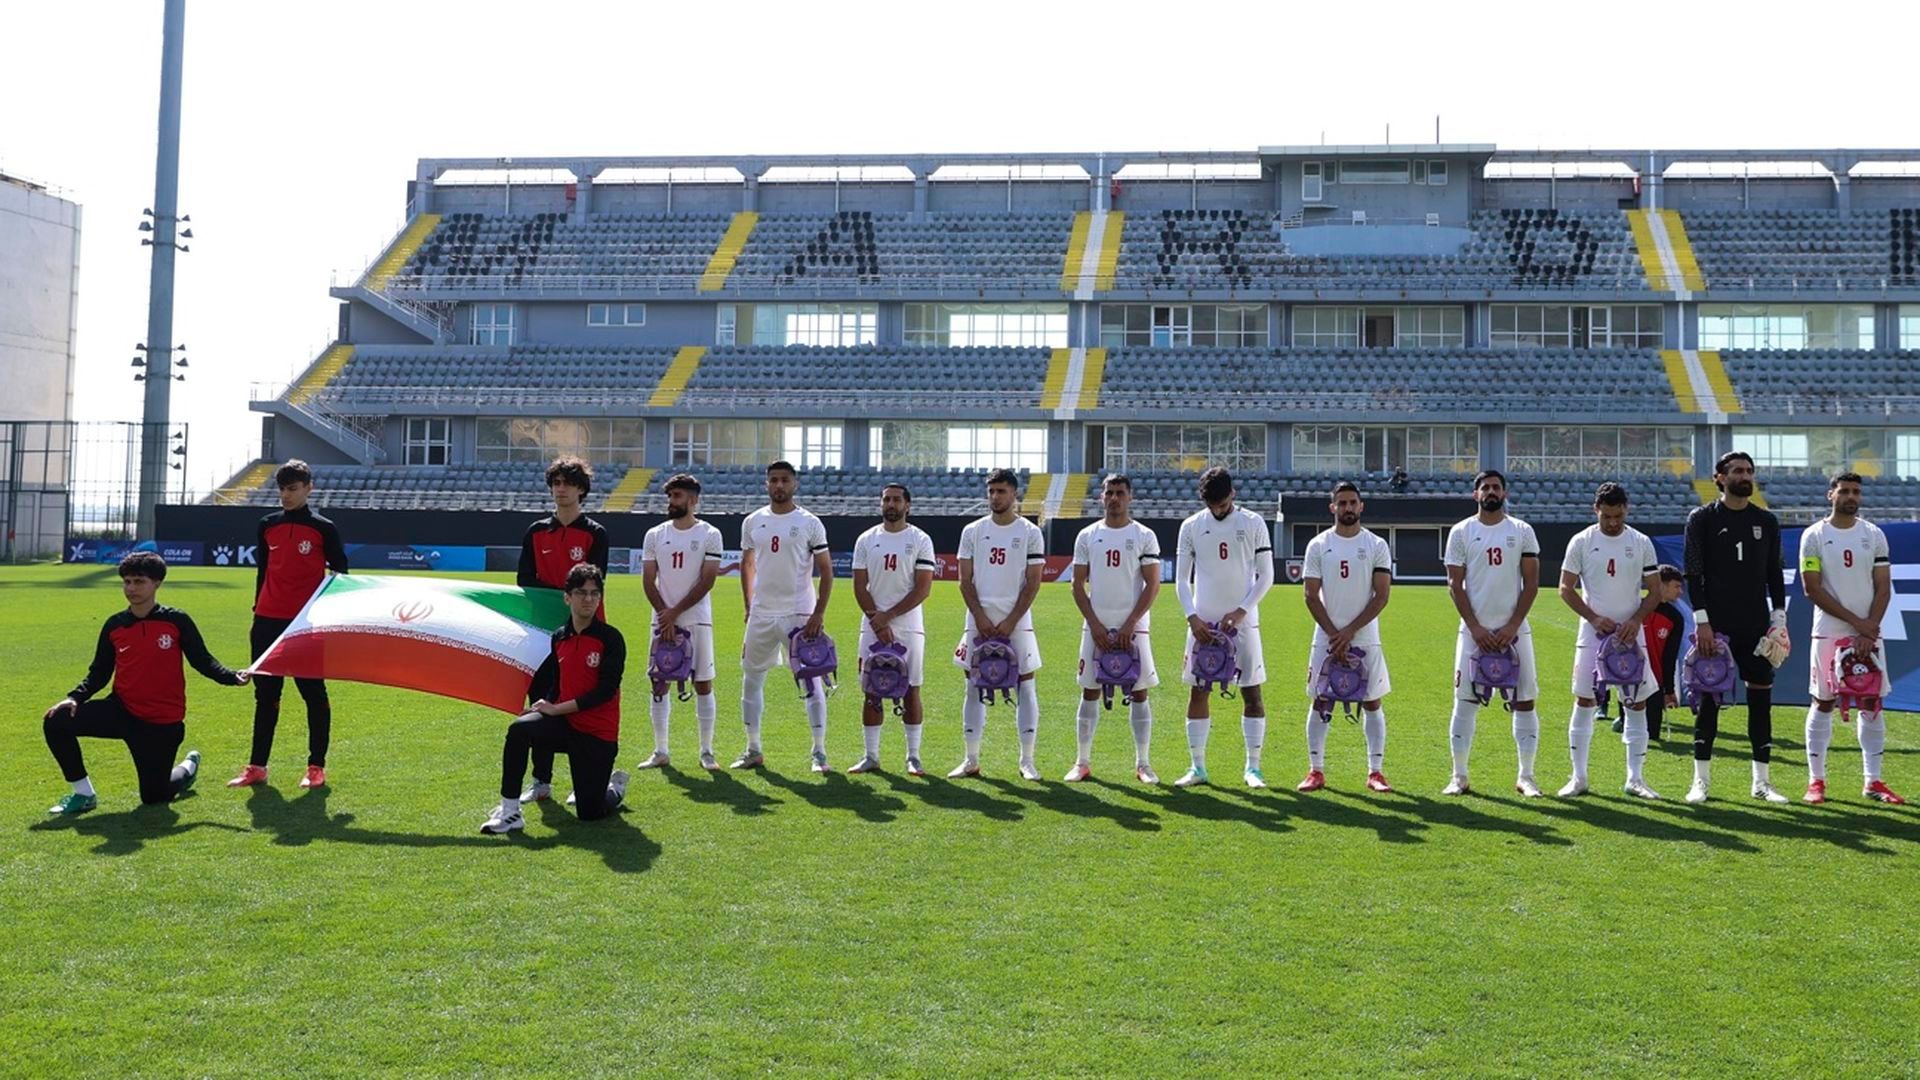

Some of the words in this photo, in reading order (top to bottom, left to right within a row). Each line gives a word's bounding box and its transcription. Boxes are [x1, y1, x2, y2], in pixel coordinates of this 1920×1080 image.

[771, 535, 780, 553] 8
[1219, 542, 1228, 560] 6
[1735, 541, 1743, 561] 1
[671, 551, 684, 569] 11
[883, 553, 897, 571] 14
[989, 547, 1006, 565] 35
[1105, 549, 1121, 567] 19
[1486, 547, 1503, 566] 13
[1843, 549, 1853, 568] 9
[1340, 560, 1349, 579] 5
[1606, 558, 1616, 577] 4
